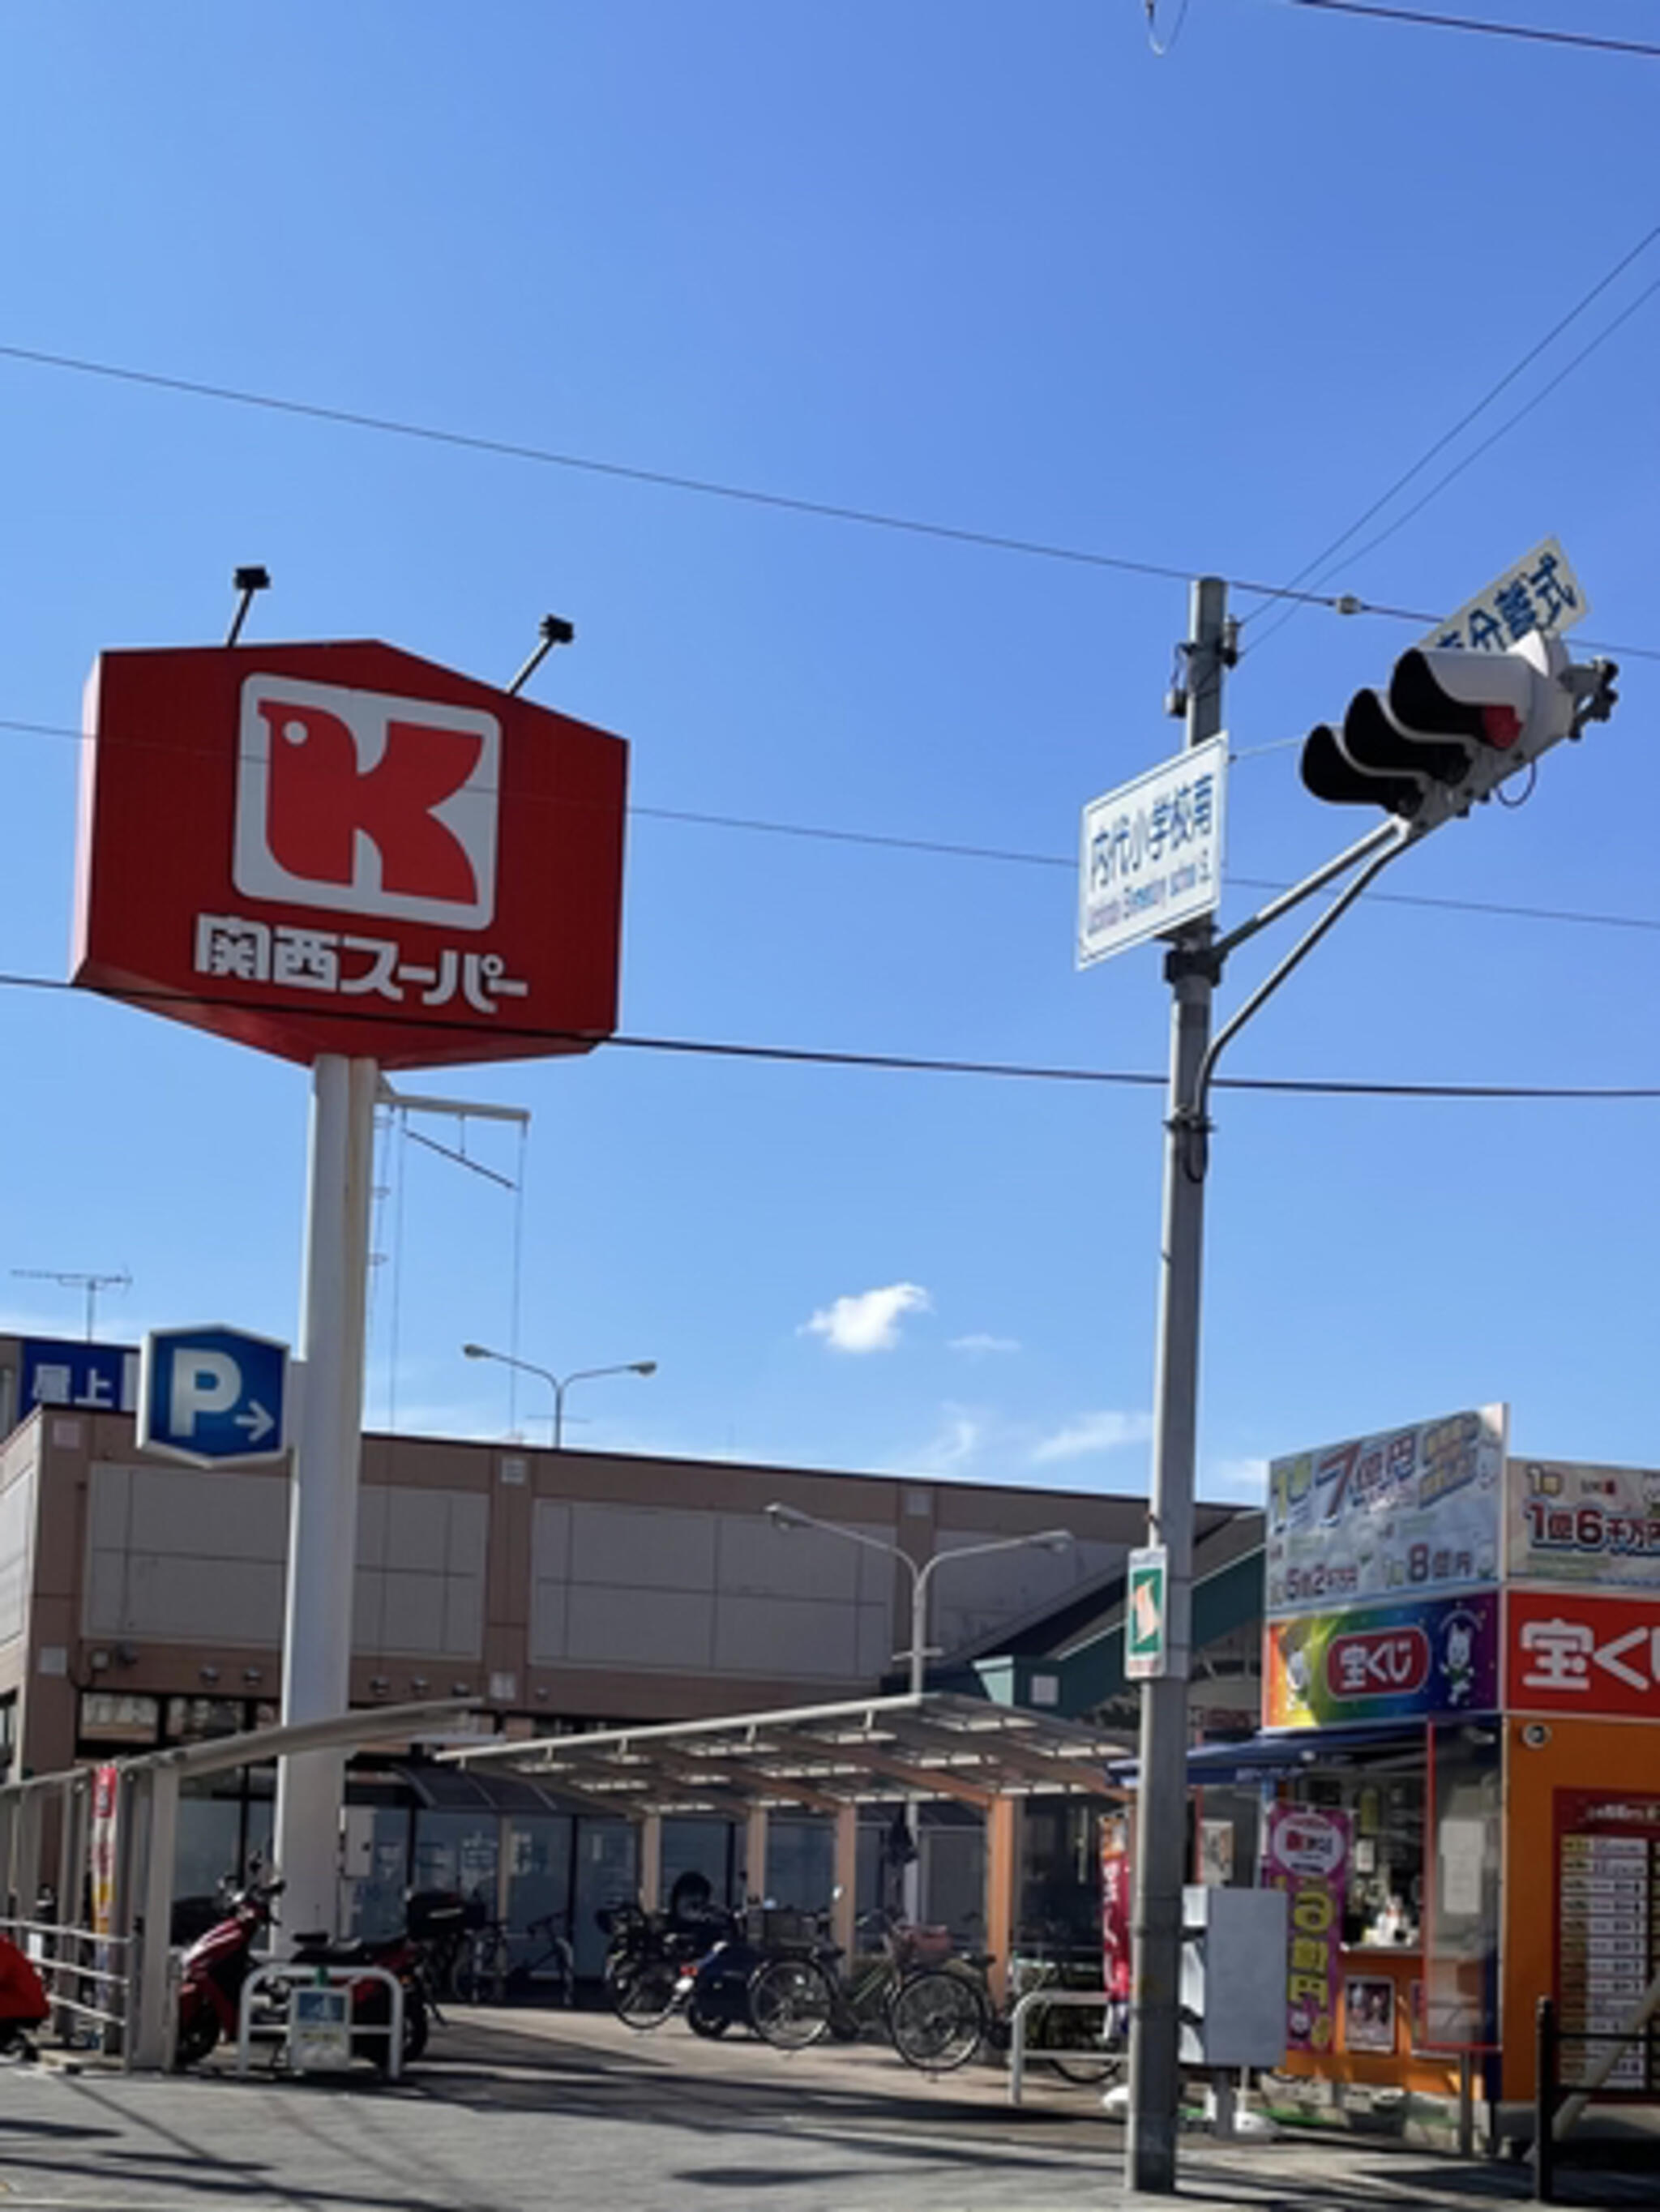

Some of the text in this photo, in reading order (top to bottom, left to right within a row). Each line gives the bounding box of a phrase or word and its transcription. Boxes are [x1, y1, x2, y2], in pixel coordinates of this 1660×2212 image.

[195, 913, 528, 1012] 関西スーパー
[169, 1348, 242, 1436] P
[1340, 1638, 1413, 1690] 宝くじ
[1520, 1618, 1660, 1691] 宝く
